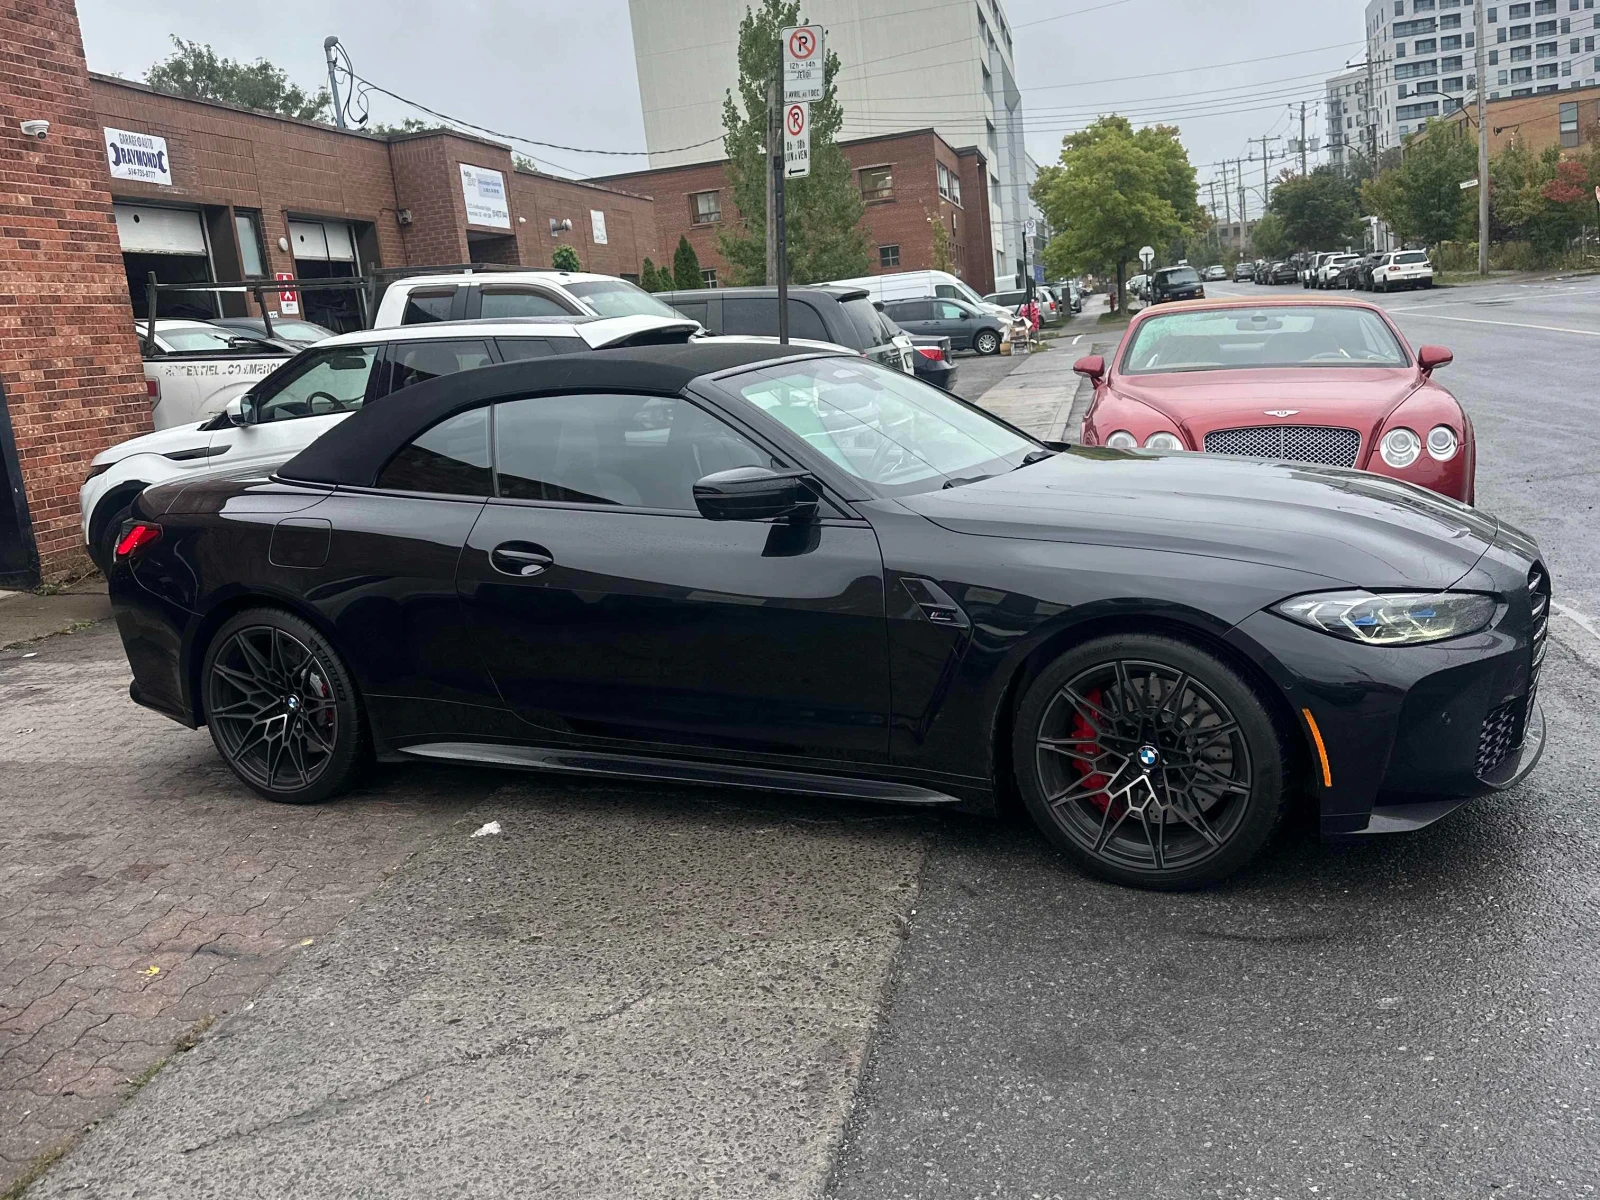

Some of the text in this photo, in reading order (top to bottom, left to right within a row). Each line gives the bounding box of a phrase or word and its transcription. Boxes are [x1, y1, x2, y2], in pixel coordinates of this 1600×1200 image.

[789, 62, 799, 70] 12h
[796, 69, 811, 79] JEUDI
[789, 90, 801, 98] AVRIL
[119, 133, 137, 146] GARAGE
[786, 141, 793, 151] 8h
[797, 139, 805, 149] 18h
[120, 147, 157, 168] RAYMOND
[784, 152, 794, 162] LUN
[798, 149, 808, 160] VEN
